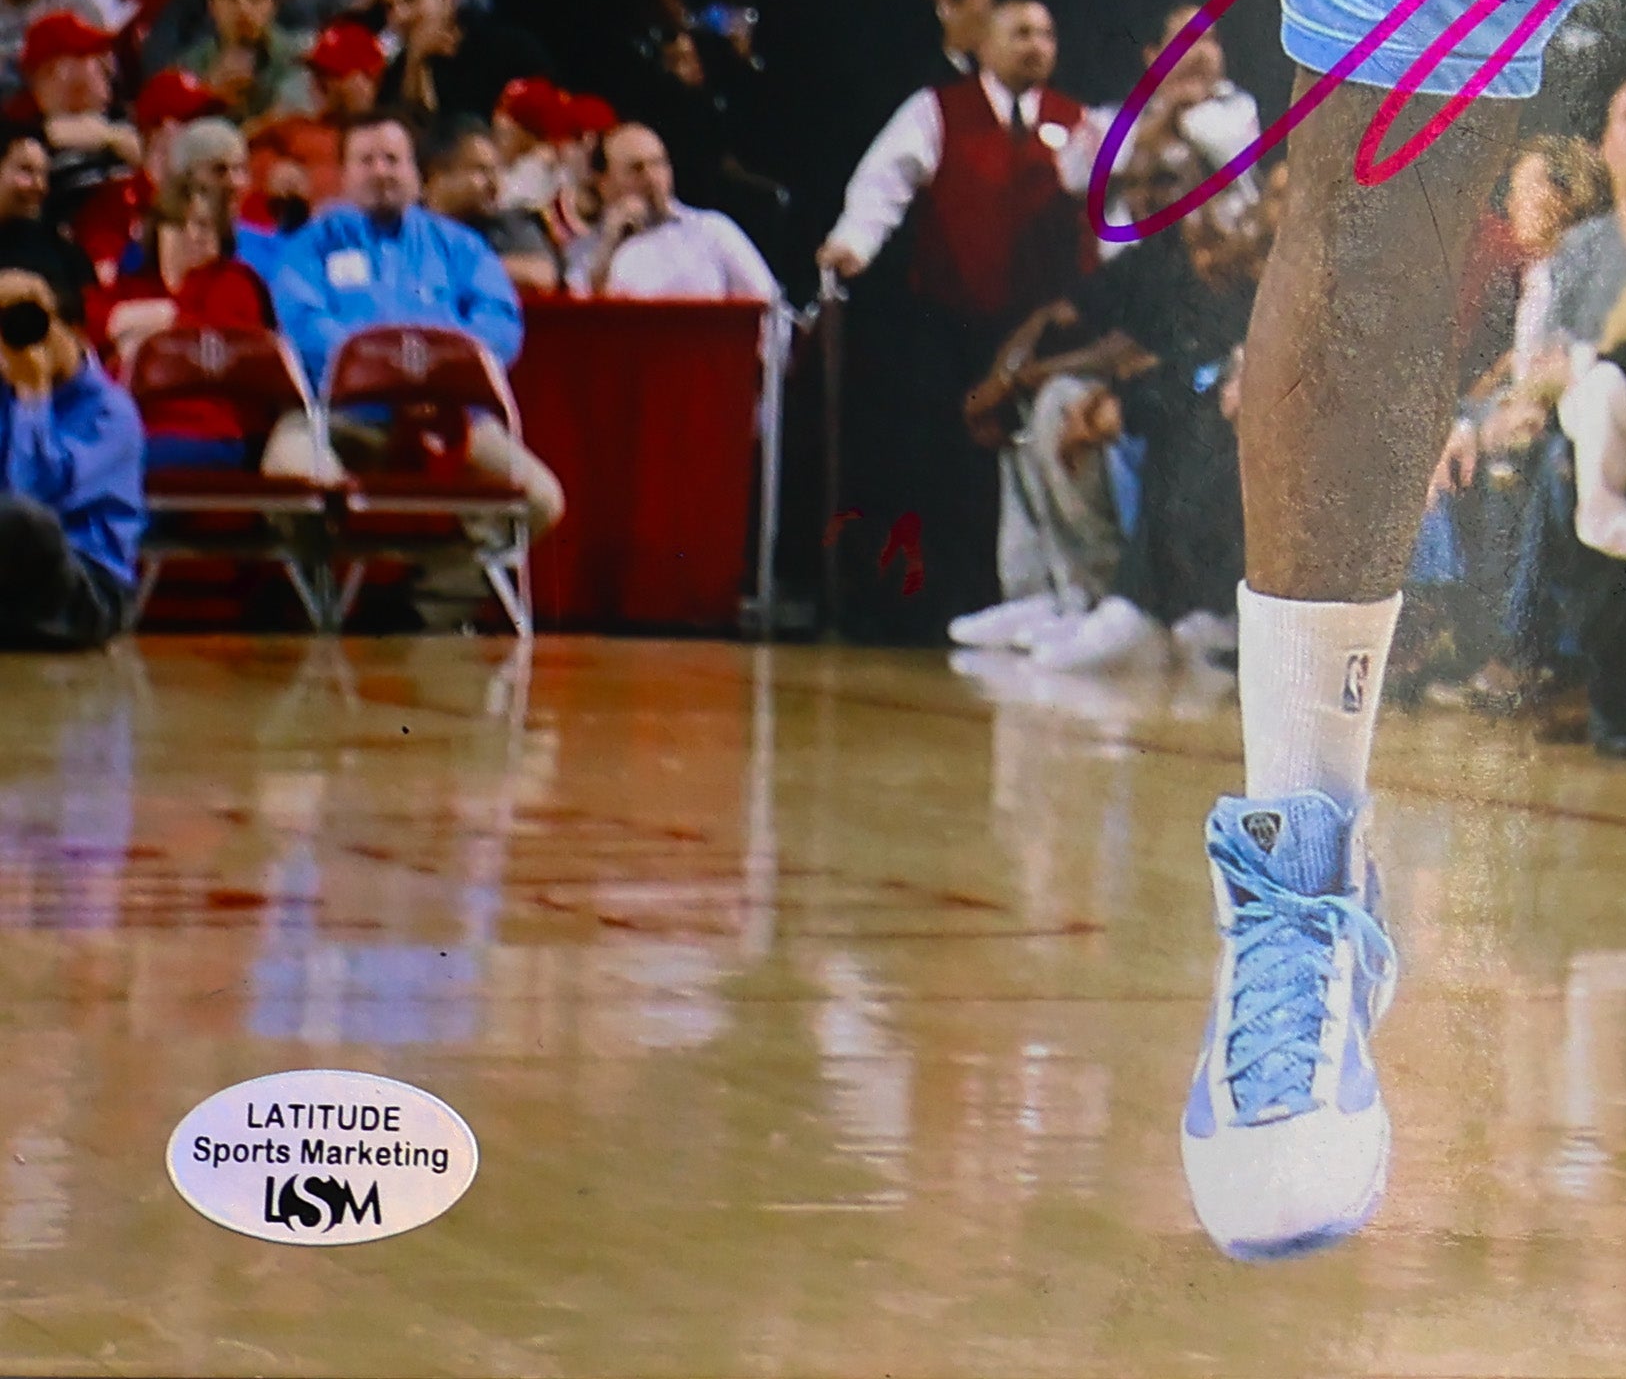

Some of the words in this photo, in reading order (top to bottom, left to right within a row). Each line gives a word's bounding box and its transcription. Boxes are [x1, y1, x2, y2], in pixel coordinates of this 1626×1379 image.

[247, 1103, 401, 1132] LATITUDE
[192, 1136, 291, 1169] Sports
[300, 1139, 450, 1174] Marketing
